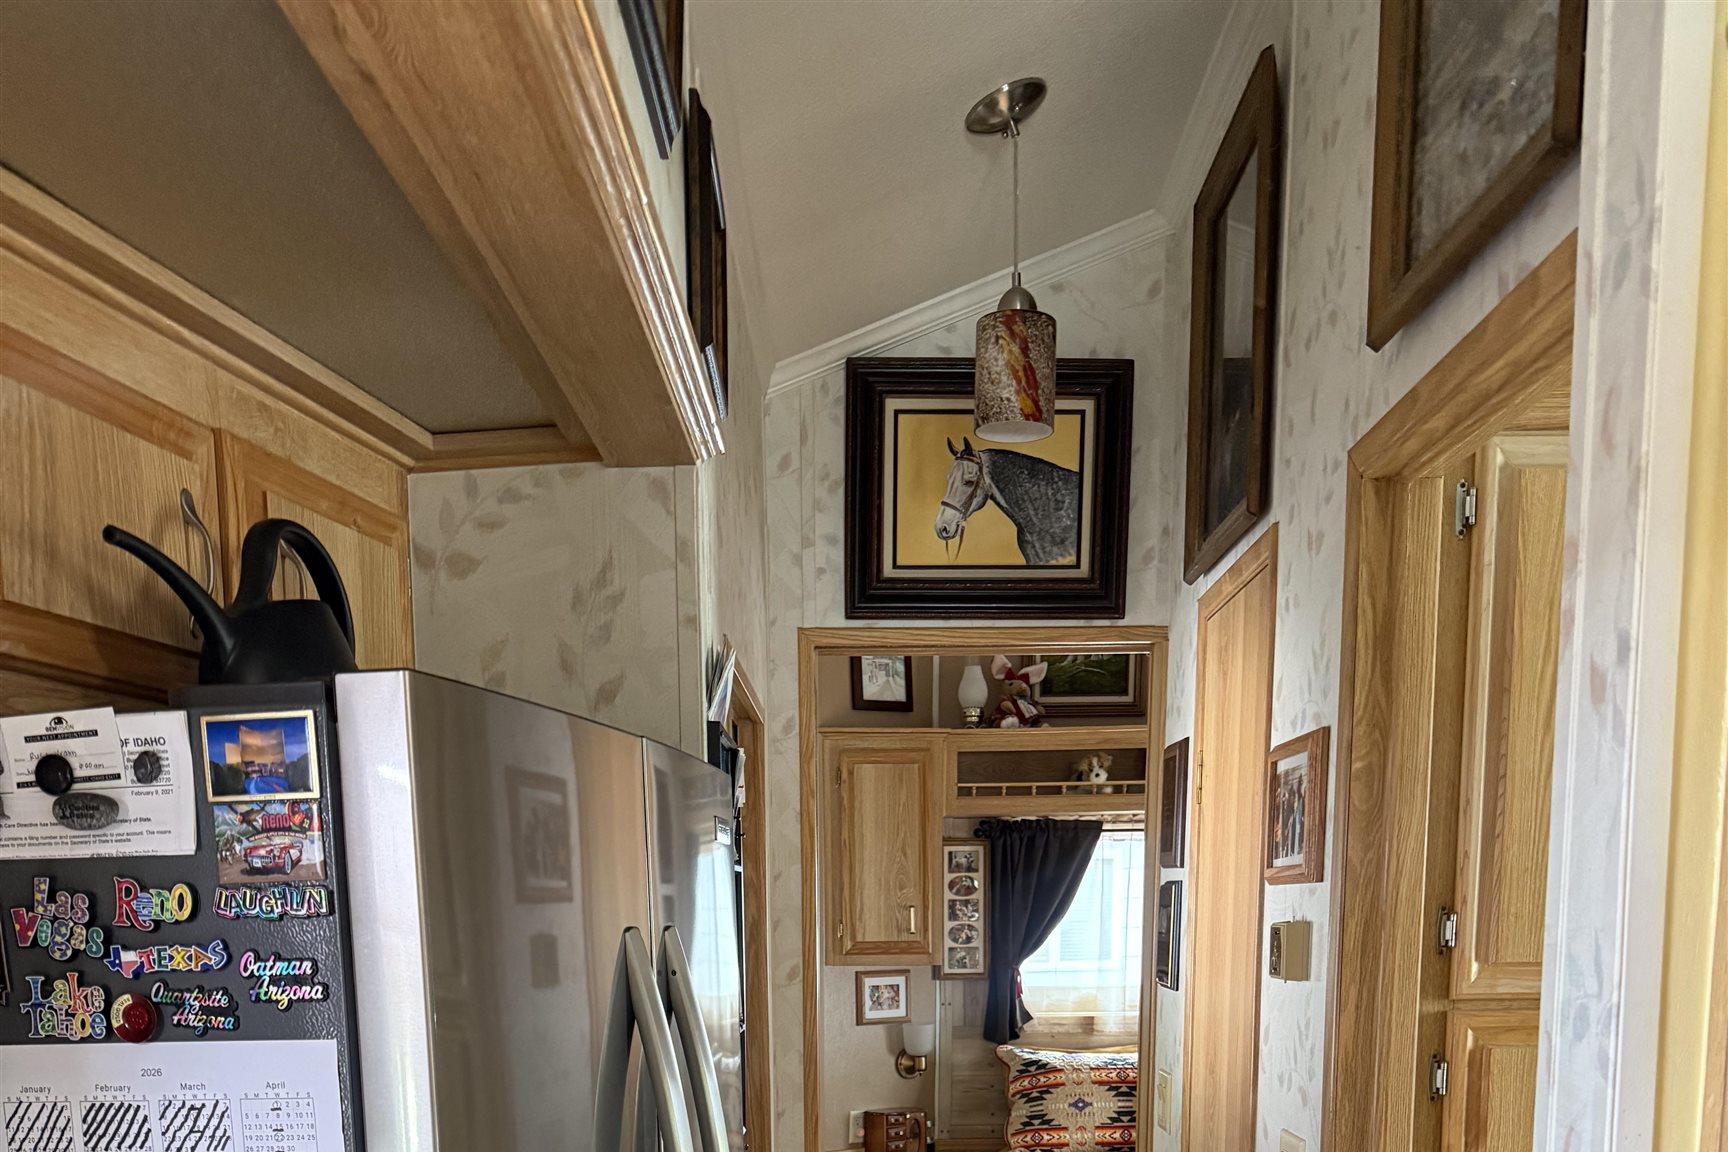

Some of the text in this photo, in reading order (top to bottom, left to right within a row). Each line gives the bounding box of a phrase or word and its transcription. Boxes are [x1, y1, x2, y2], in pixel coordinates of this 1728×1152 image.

[133, 737, 166, 747] IDAHO
[33, 877, 90, 923] Las
[112, 876, 193, 931] Reno
[213, 886, 330, 921] LAUGHLIN
[10, 907, 104, 961] Vegas
[138, 939, 228, 973] TEXAS
[239, 951, 314, 978] Oatman
[25, 972, 105, 1014] Lake
[117, 997, 131, 1007] REAL
[151, 981, 230, 1014] Quartzsite
[249, 976, 325, 1010] Arizona
[20, 1003, 107, 1041] Tahoe
[172, 1005, 235, 1036] Arizona
[95, 1084, 130, 1093] February
[141, 1068, 162, 1077] 2026
[266, 1081, 285, 1090] April
[20, 1086, 51, 1094] January
